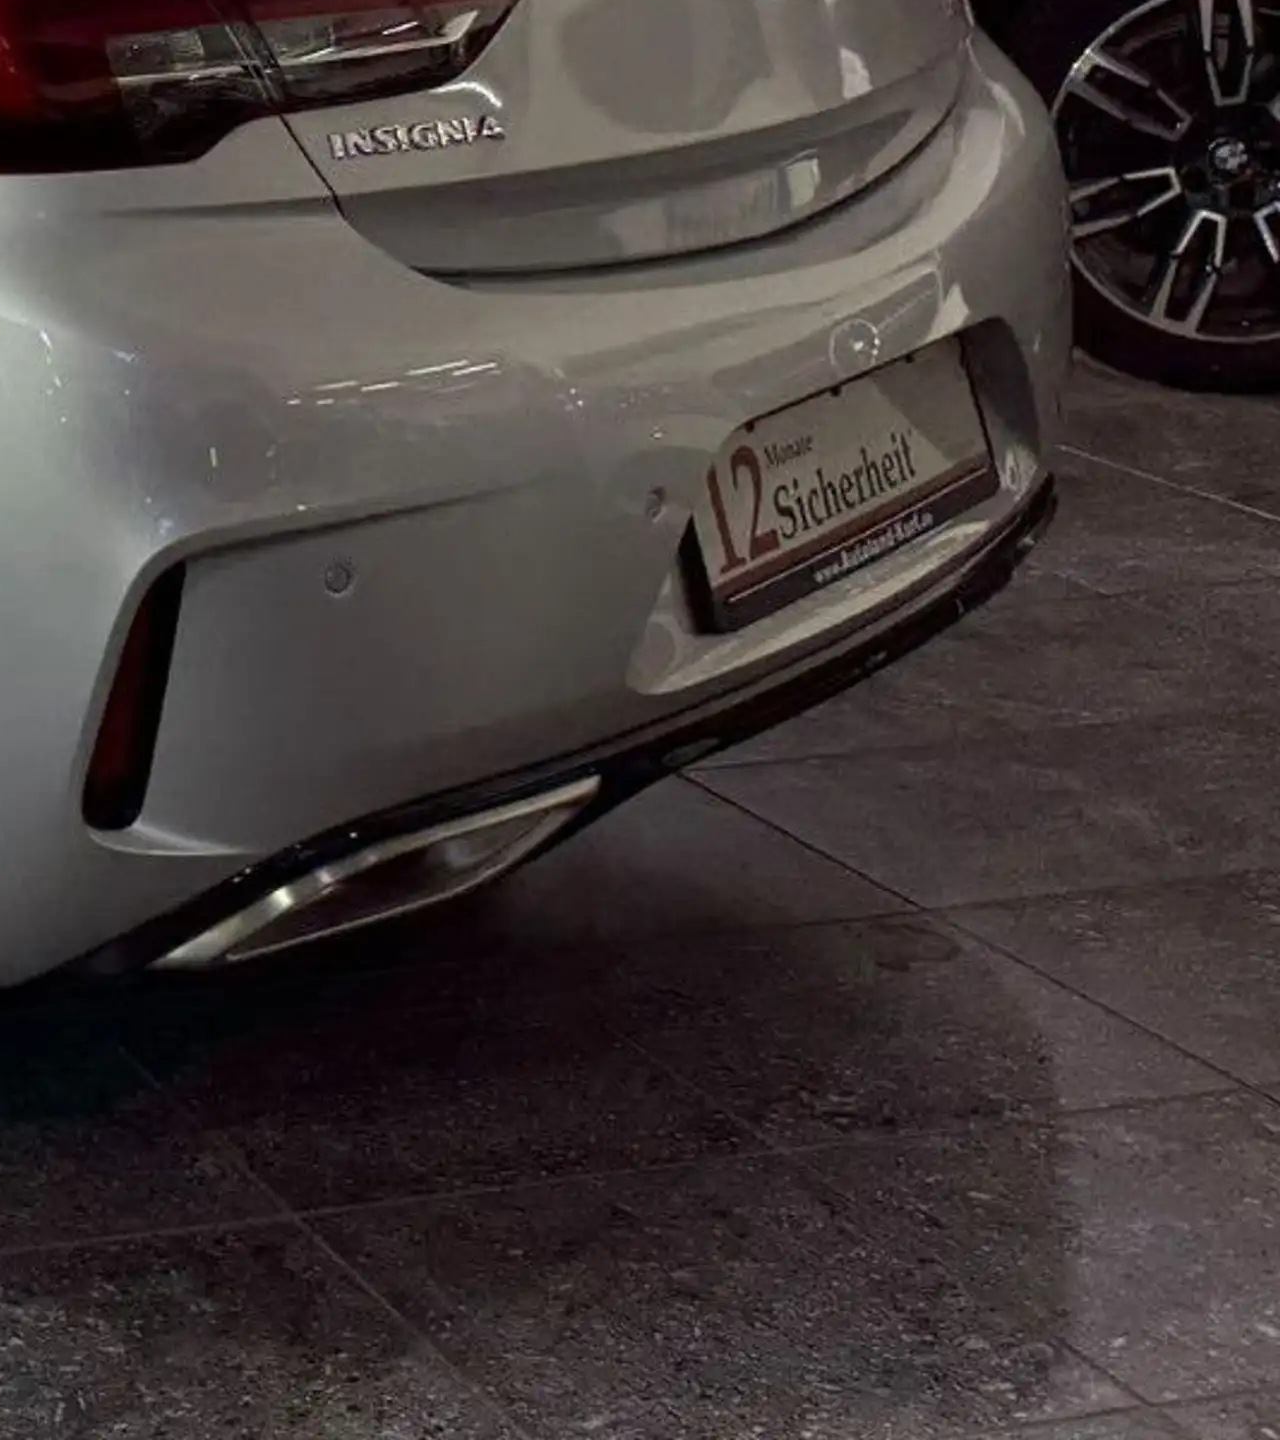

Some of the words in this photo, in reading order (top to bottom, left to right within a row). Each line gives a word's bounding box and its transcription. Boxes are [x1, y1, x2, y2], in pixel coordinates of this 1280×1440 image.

[327, 115, 505, 159] INSIGNIA
[765, 434, 814, 470] Monate
[773, 430, 918, 539] Sicherheit
[706, 444, 781, 575] 12
